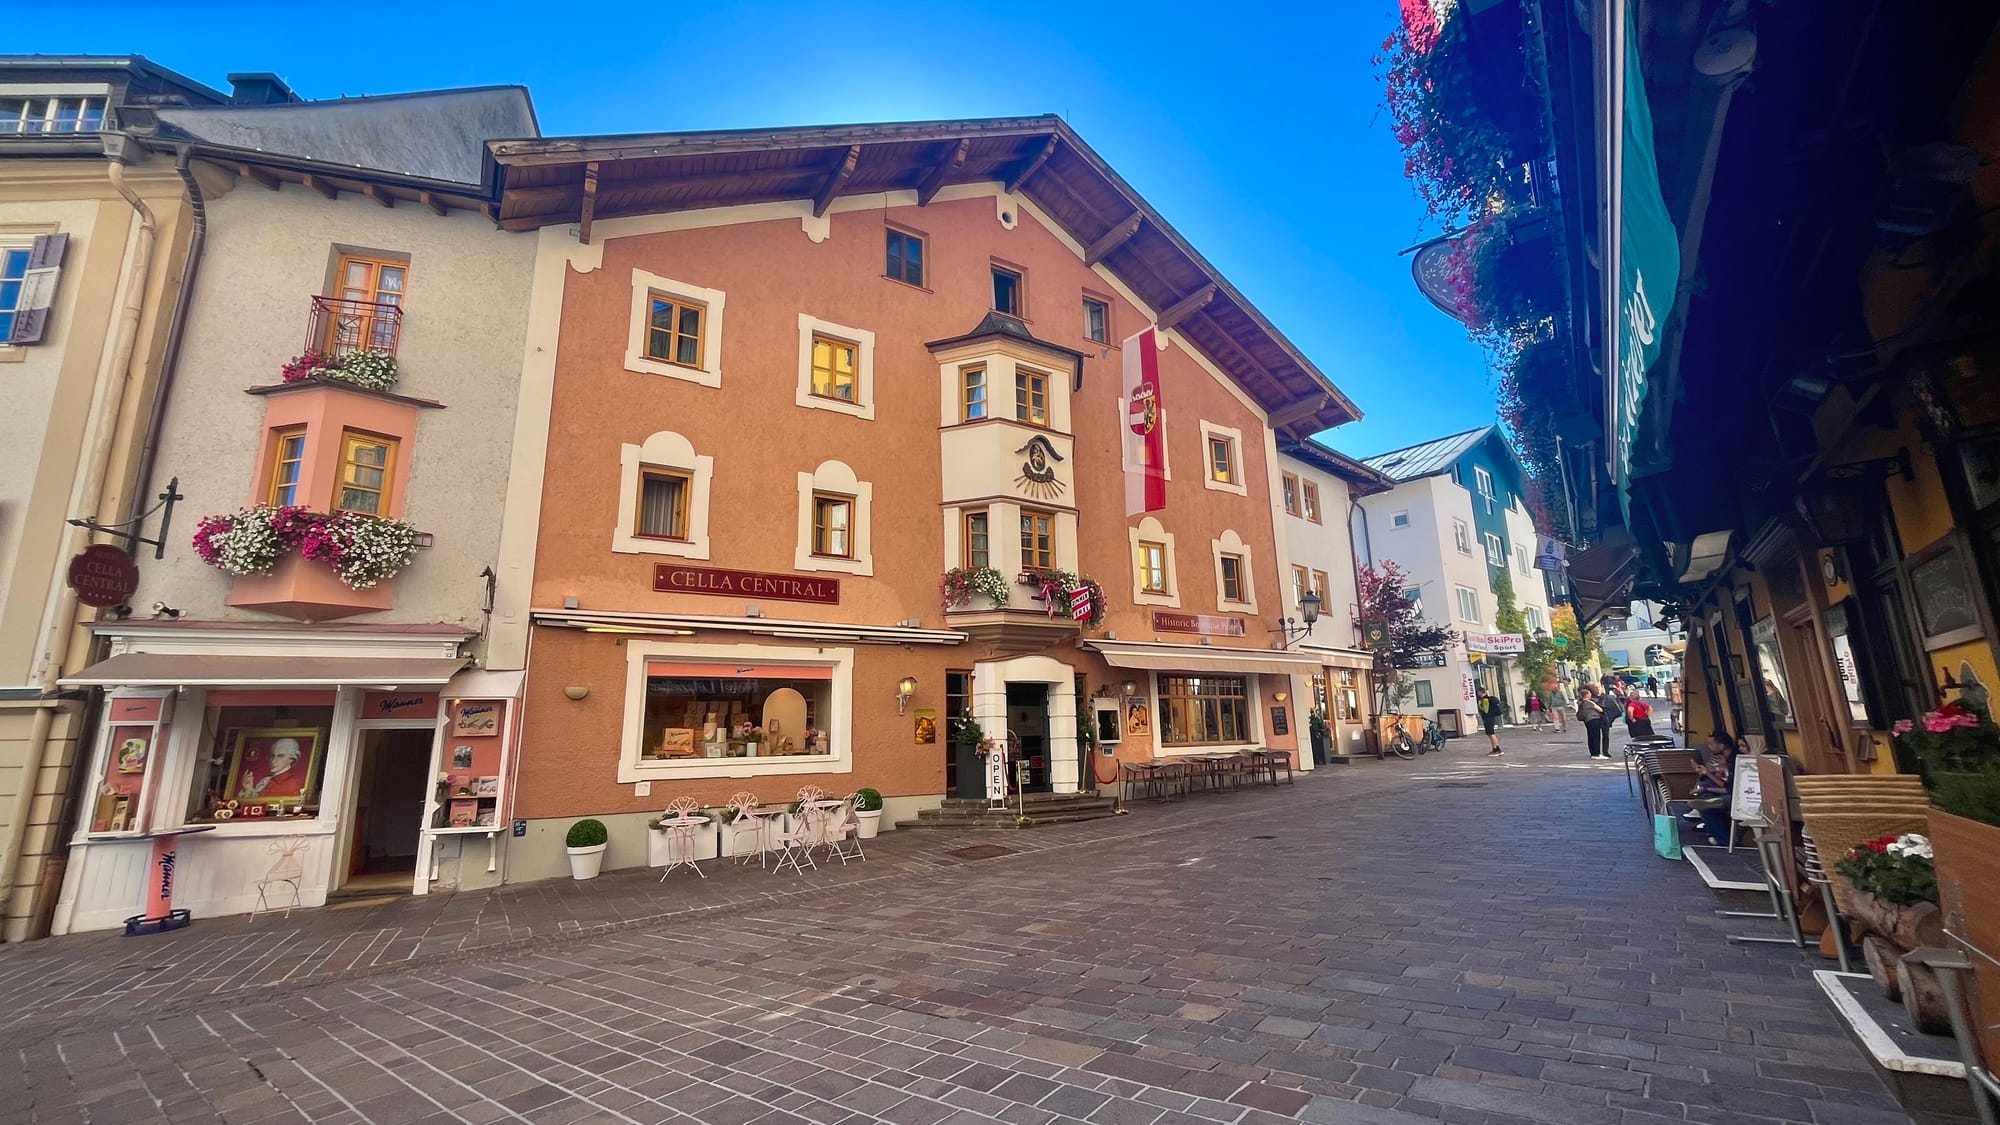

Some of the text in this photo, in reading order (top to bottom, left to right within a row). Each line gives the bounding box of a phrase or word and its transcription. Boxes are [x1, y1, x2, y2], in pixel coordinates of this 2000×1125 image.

[87, 561, 122, 577] CELLA
[74, 574, 128, 592] CENTRAL
[670, 571, 826, 597] CELLA CENTRAL
[1161, 616, 1190, 628] Historic
[1487, 636, 1521, 644] SkiPro
[1462, 673, 1470, 701] SkiPro
[380, 697, 424, 713] Manner
[992, 754, 1001, 795] OPEN
[158, 850, 176, 901] Manner
